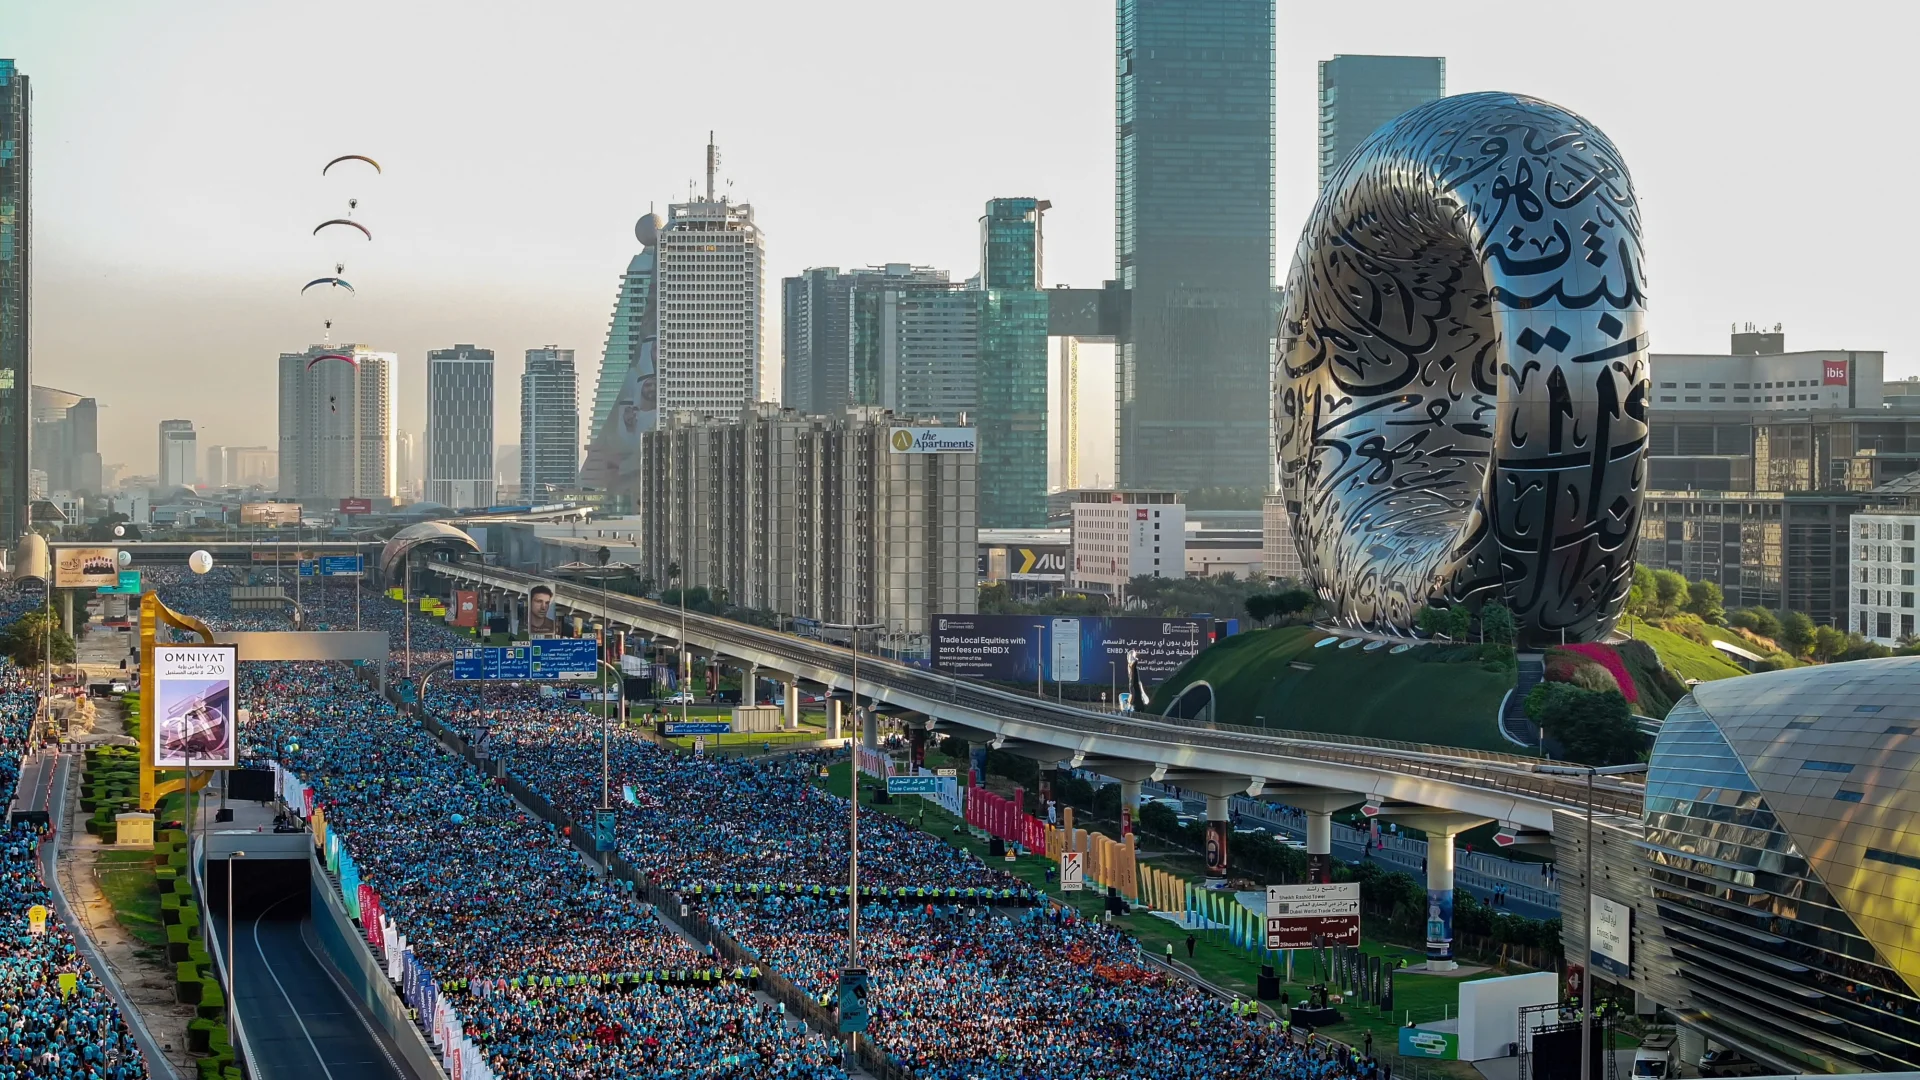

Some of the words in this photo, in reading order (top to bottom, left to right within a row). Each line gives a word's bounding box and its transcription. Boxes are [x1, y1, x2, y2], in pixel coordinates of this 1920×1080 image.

[1827, 367, 1844, 378] ibis
[922, 430, 936, 440] the
[913, 438, 974, 451] Apartments
[940, 636, 960, 644] Trade
[981, 636, 1009, 645] Equities
[1158, 638, 1165, 648] أي
[165, 653, 225, 662] OMNIYAT
[207, 665, 224, 675] 20
